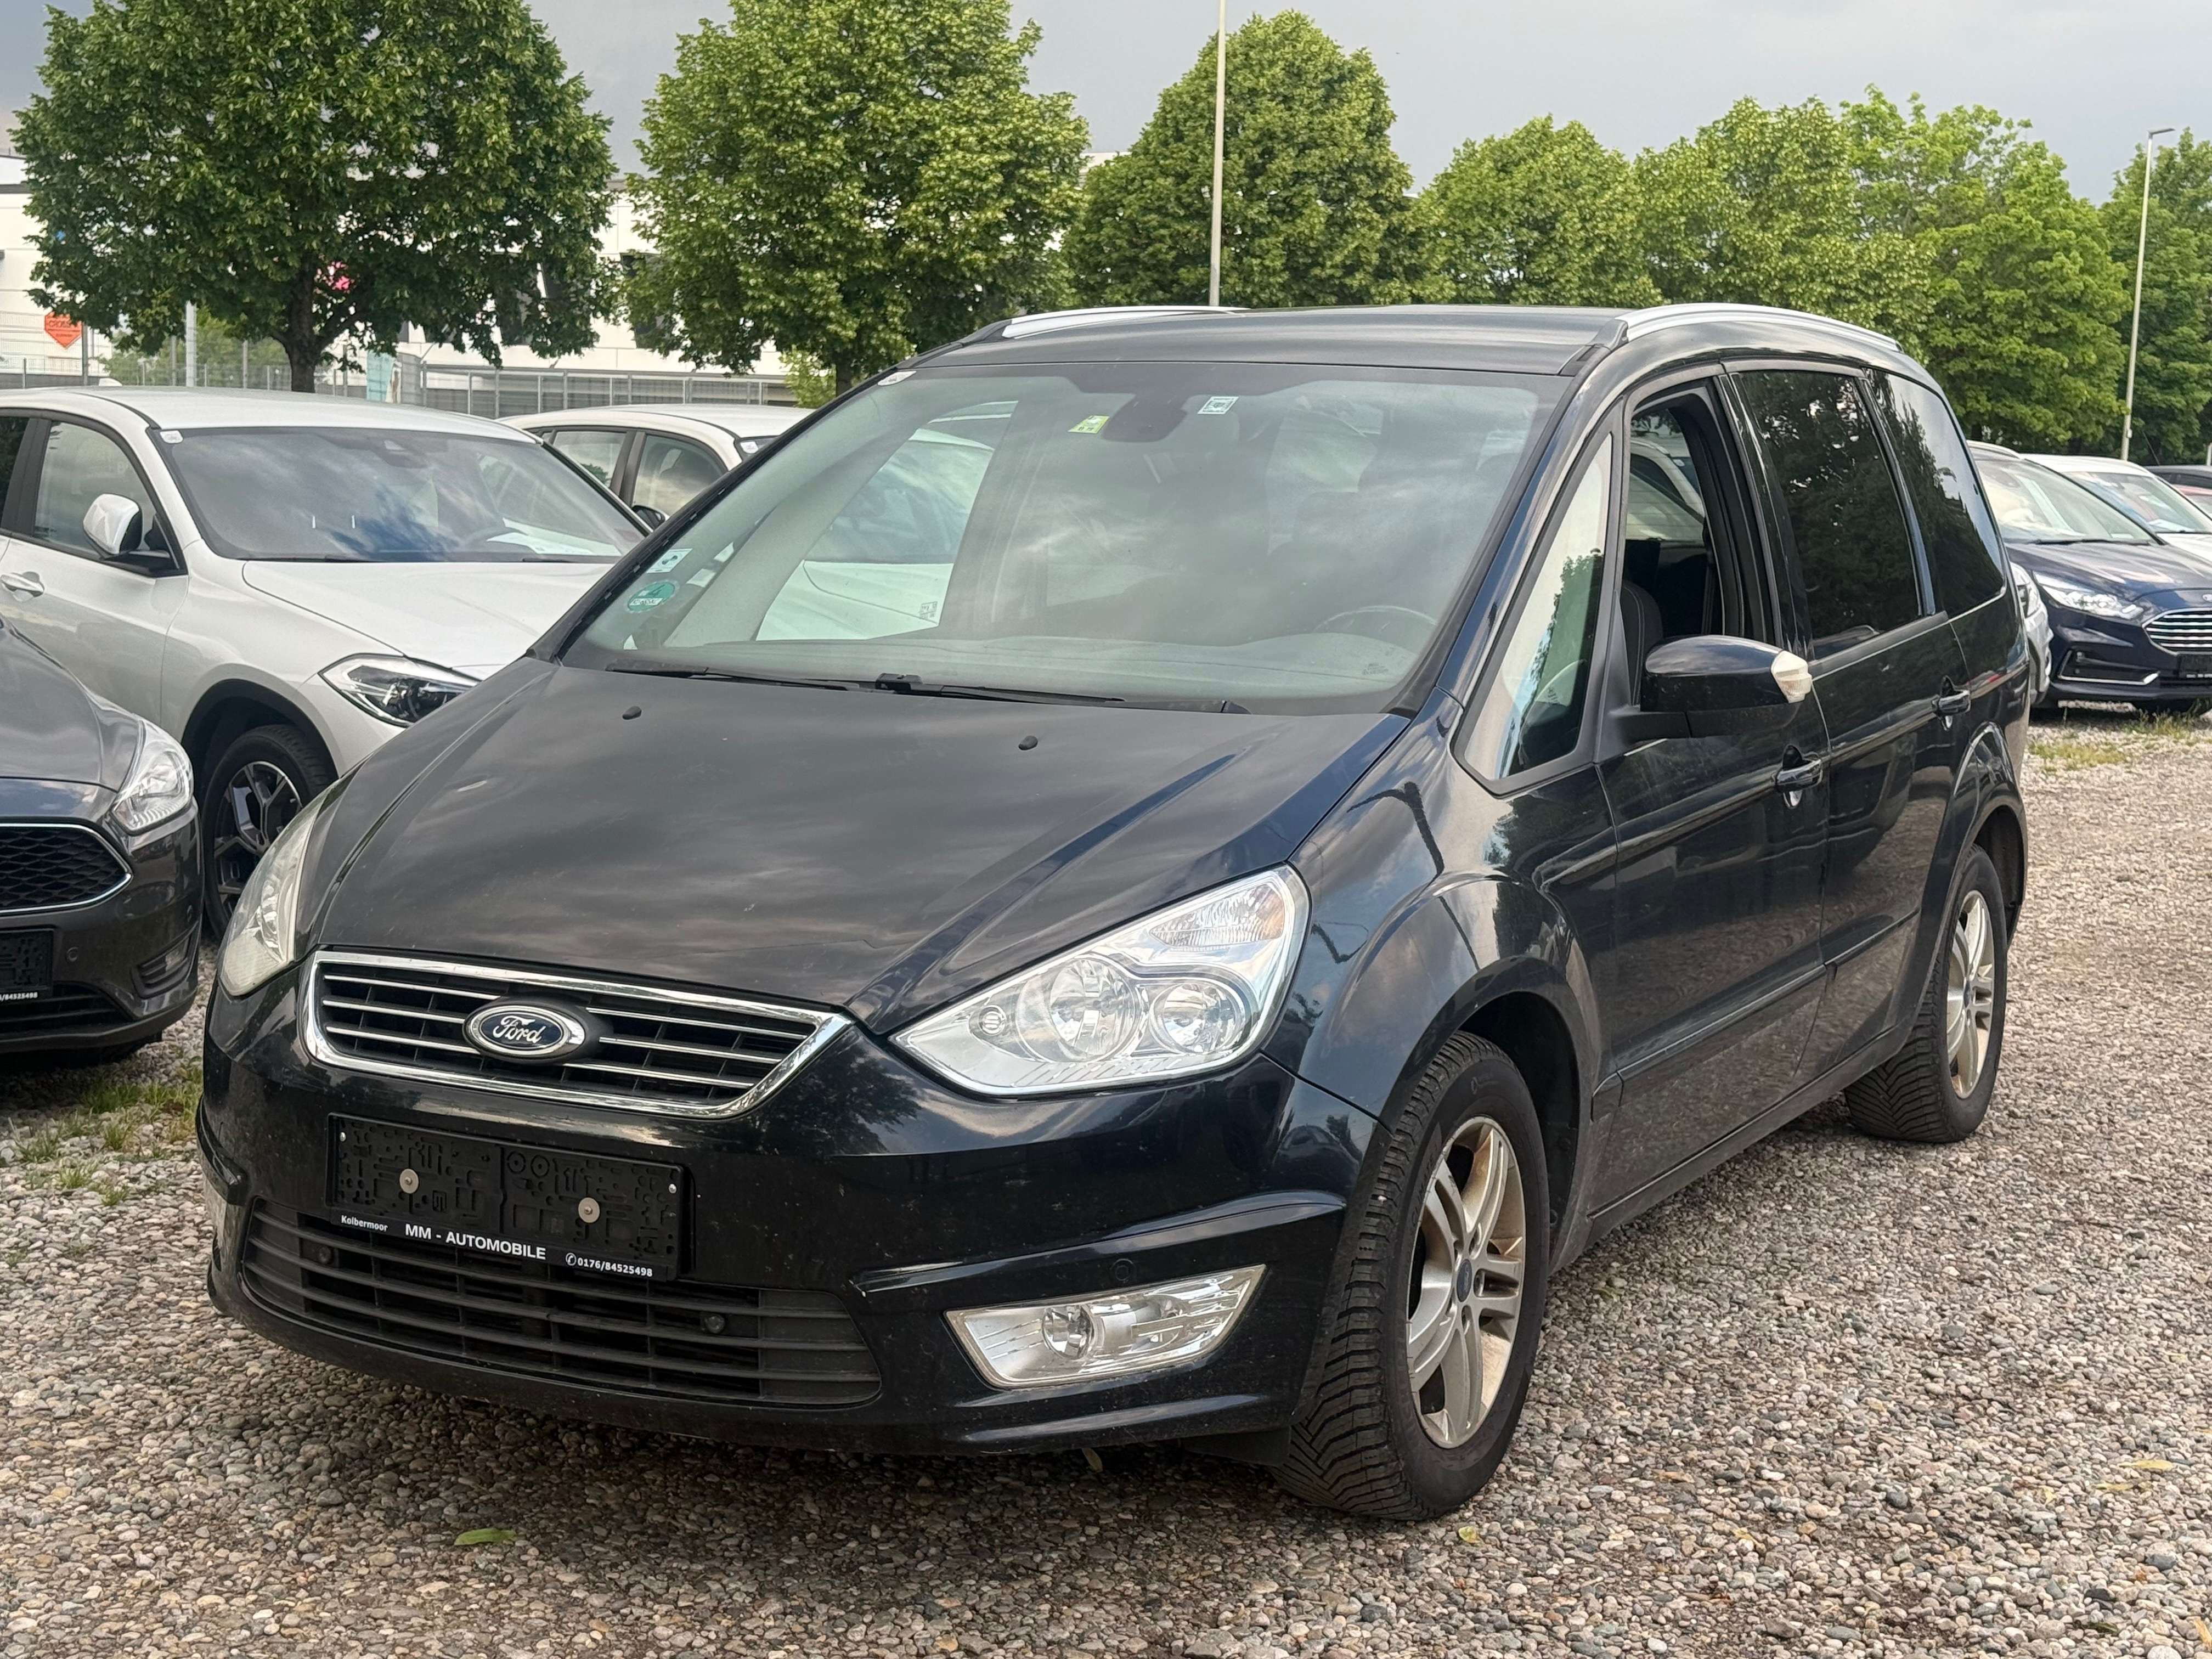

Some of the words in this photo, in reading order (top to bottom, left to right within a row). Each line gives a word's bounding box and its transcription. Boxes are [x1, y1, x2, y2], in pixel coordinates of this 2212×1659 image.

[493, 1015, 546, 1043] Ford
[341, 1215, 388, 1232] Kolbermoor
[405, 1223, 432, 1240] MM
[445, 1231, 546, 1260] AUTOMOBILE
[577, 1257, 653, 1277] 0176/84525498
